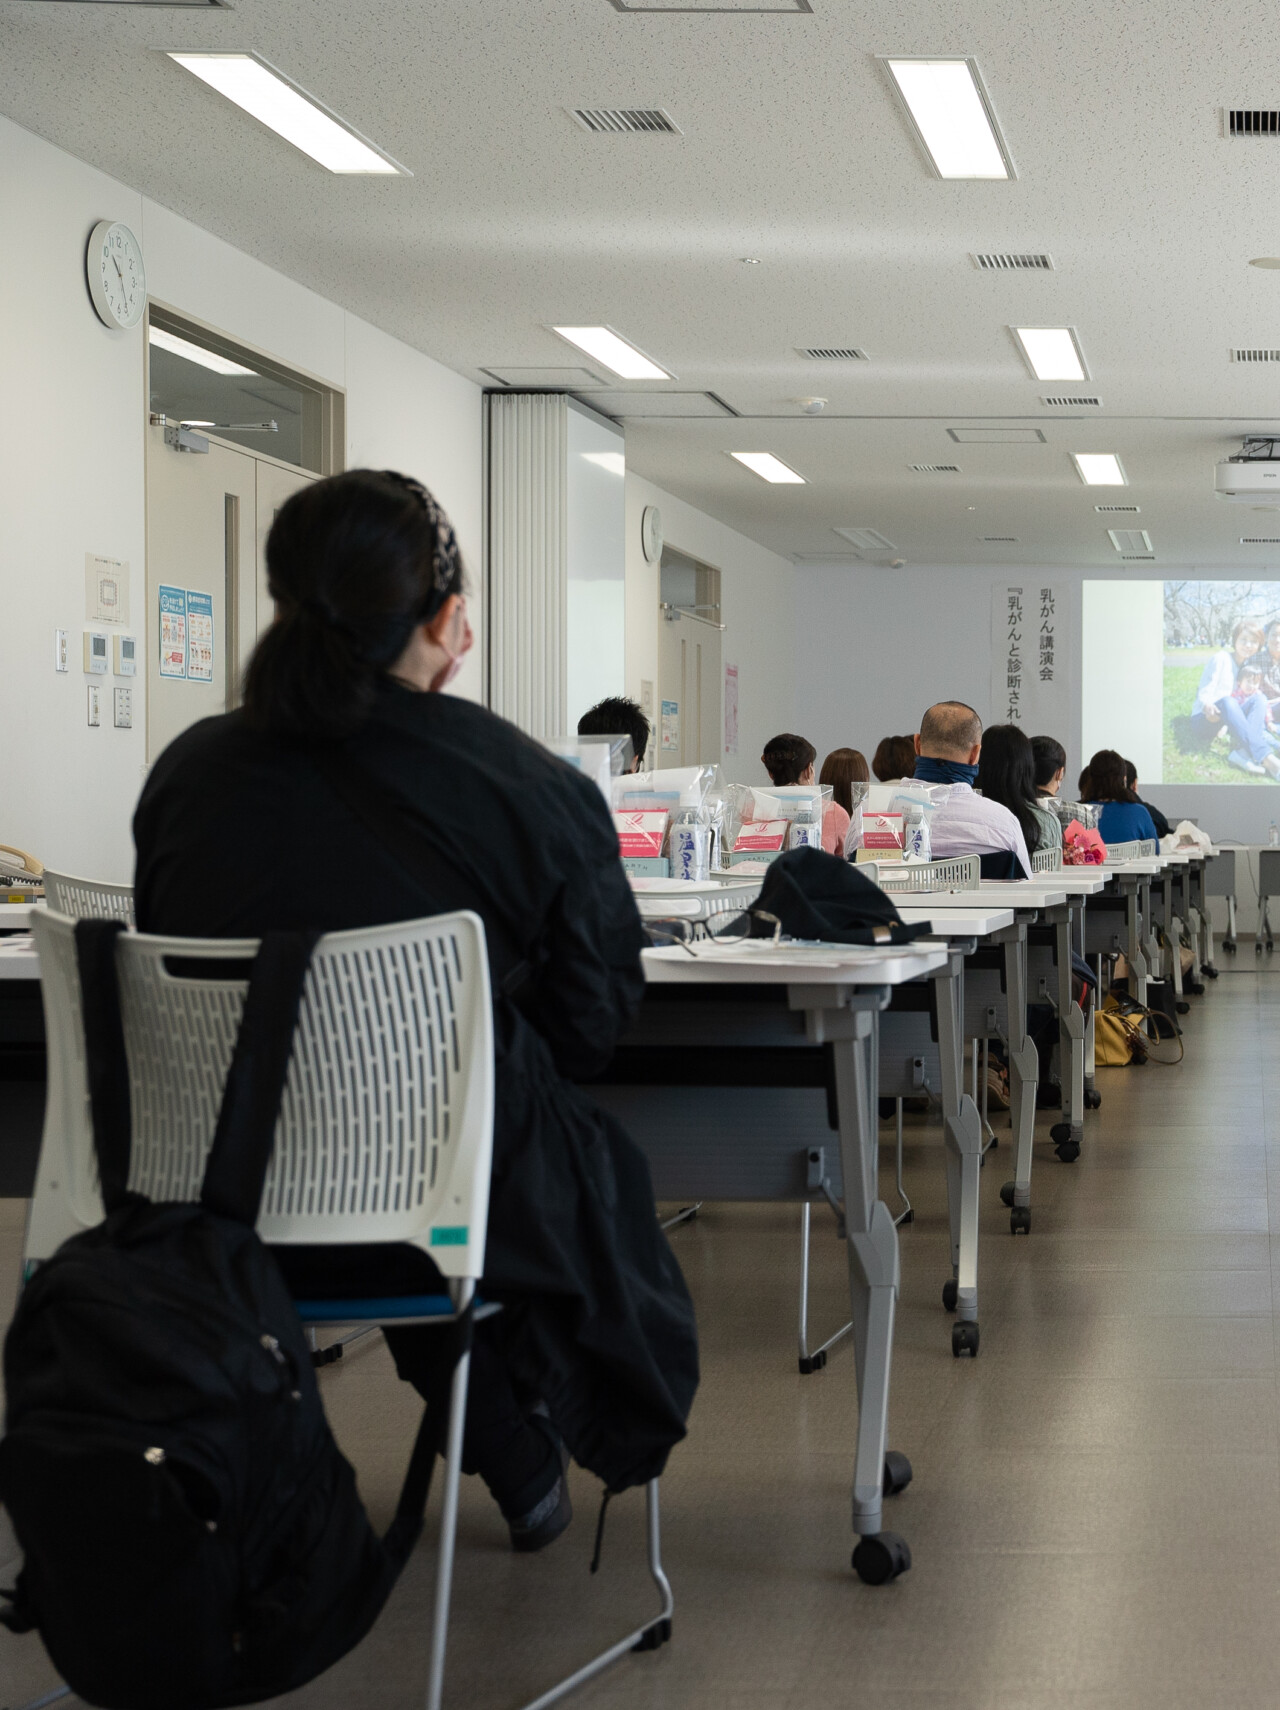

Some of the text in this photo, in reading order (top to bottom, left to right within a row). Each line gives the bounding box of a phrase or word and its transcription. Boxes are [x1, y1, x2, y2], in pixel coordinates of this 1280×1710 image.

[1039, 588, 1055, 681] 乳がん講演会
